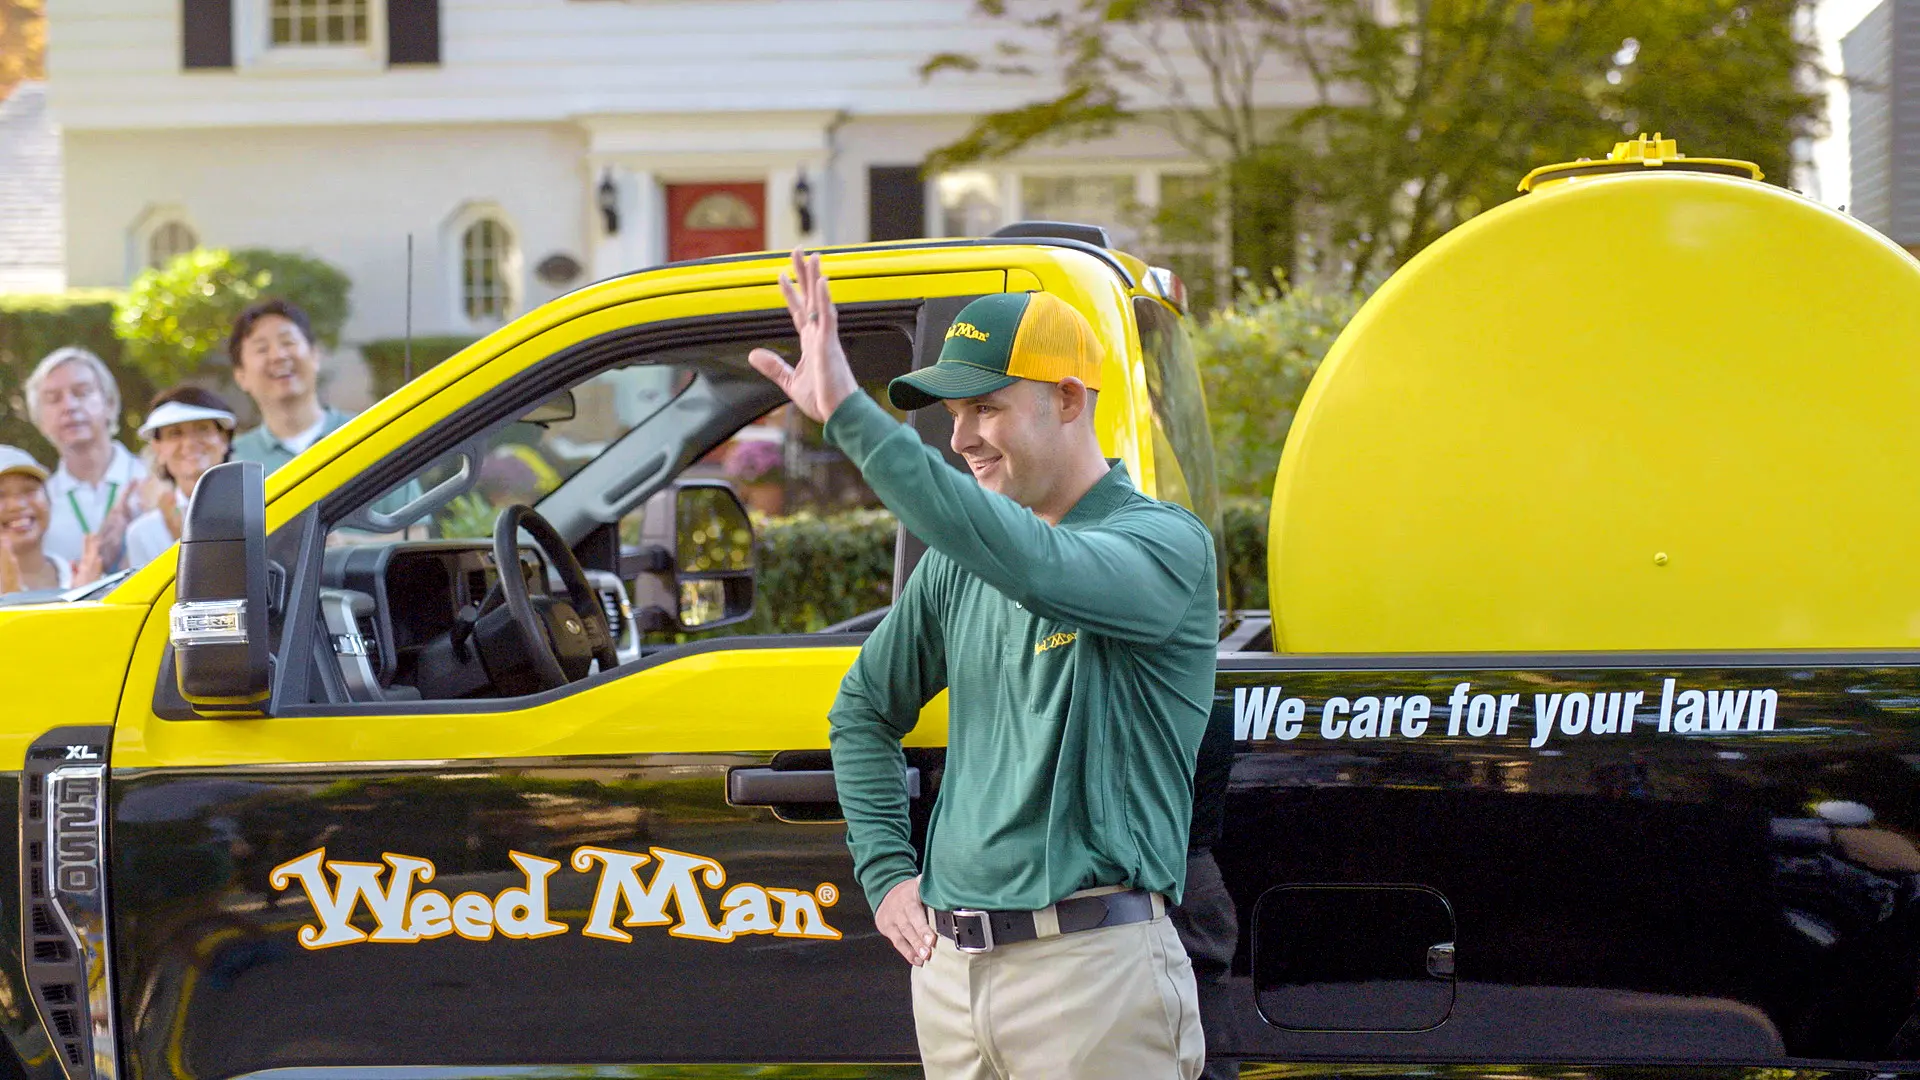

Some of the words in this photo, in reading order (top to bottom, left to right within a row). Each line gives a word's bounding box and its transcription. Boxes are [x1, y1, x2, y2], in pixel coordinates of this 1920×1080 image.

[1232, 685, 1304, 741] We
[1321, 694, 1431, 739] care
[1447, 683, 1520, 738] for
[1531, 690, 1645, 749] your
[1658, 678, 1779, 734] lawn
[65, 745, 98, 760] XL
[270, 847, 569, 950] Weed
